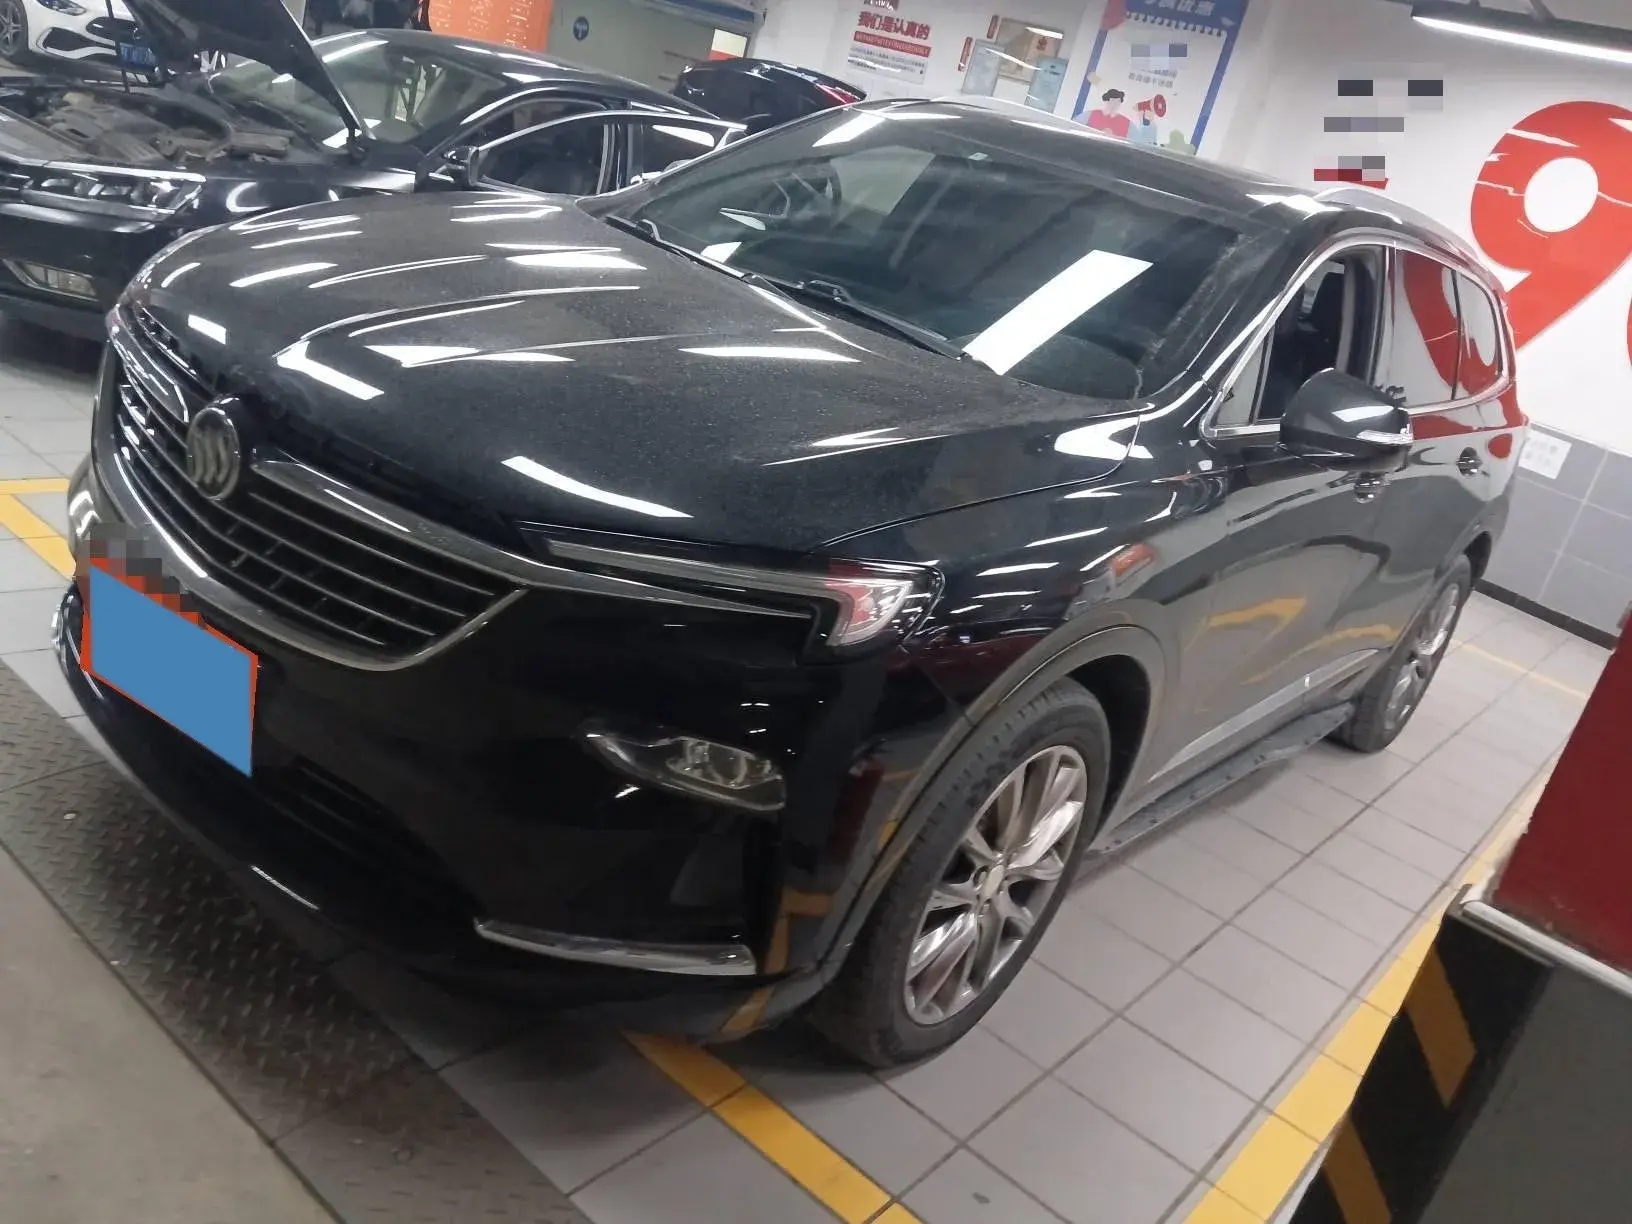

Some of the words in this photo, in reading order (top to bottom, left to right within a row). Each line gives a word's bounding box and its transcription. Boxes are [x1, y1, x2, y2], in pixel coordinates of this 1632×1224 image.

[857, 11, 931, 40] 我们是认真的
[1471, 100, 1632, 370] 9
